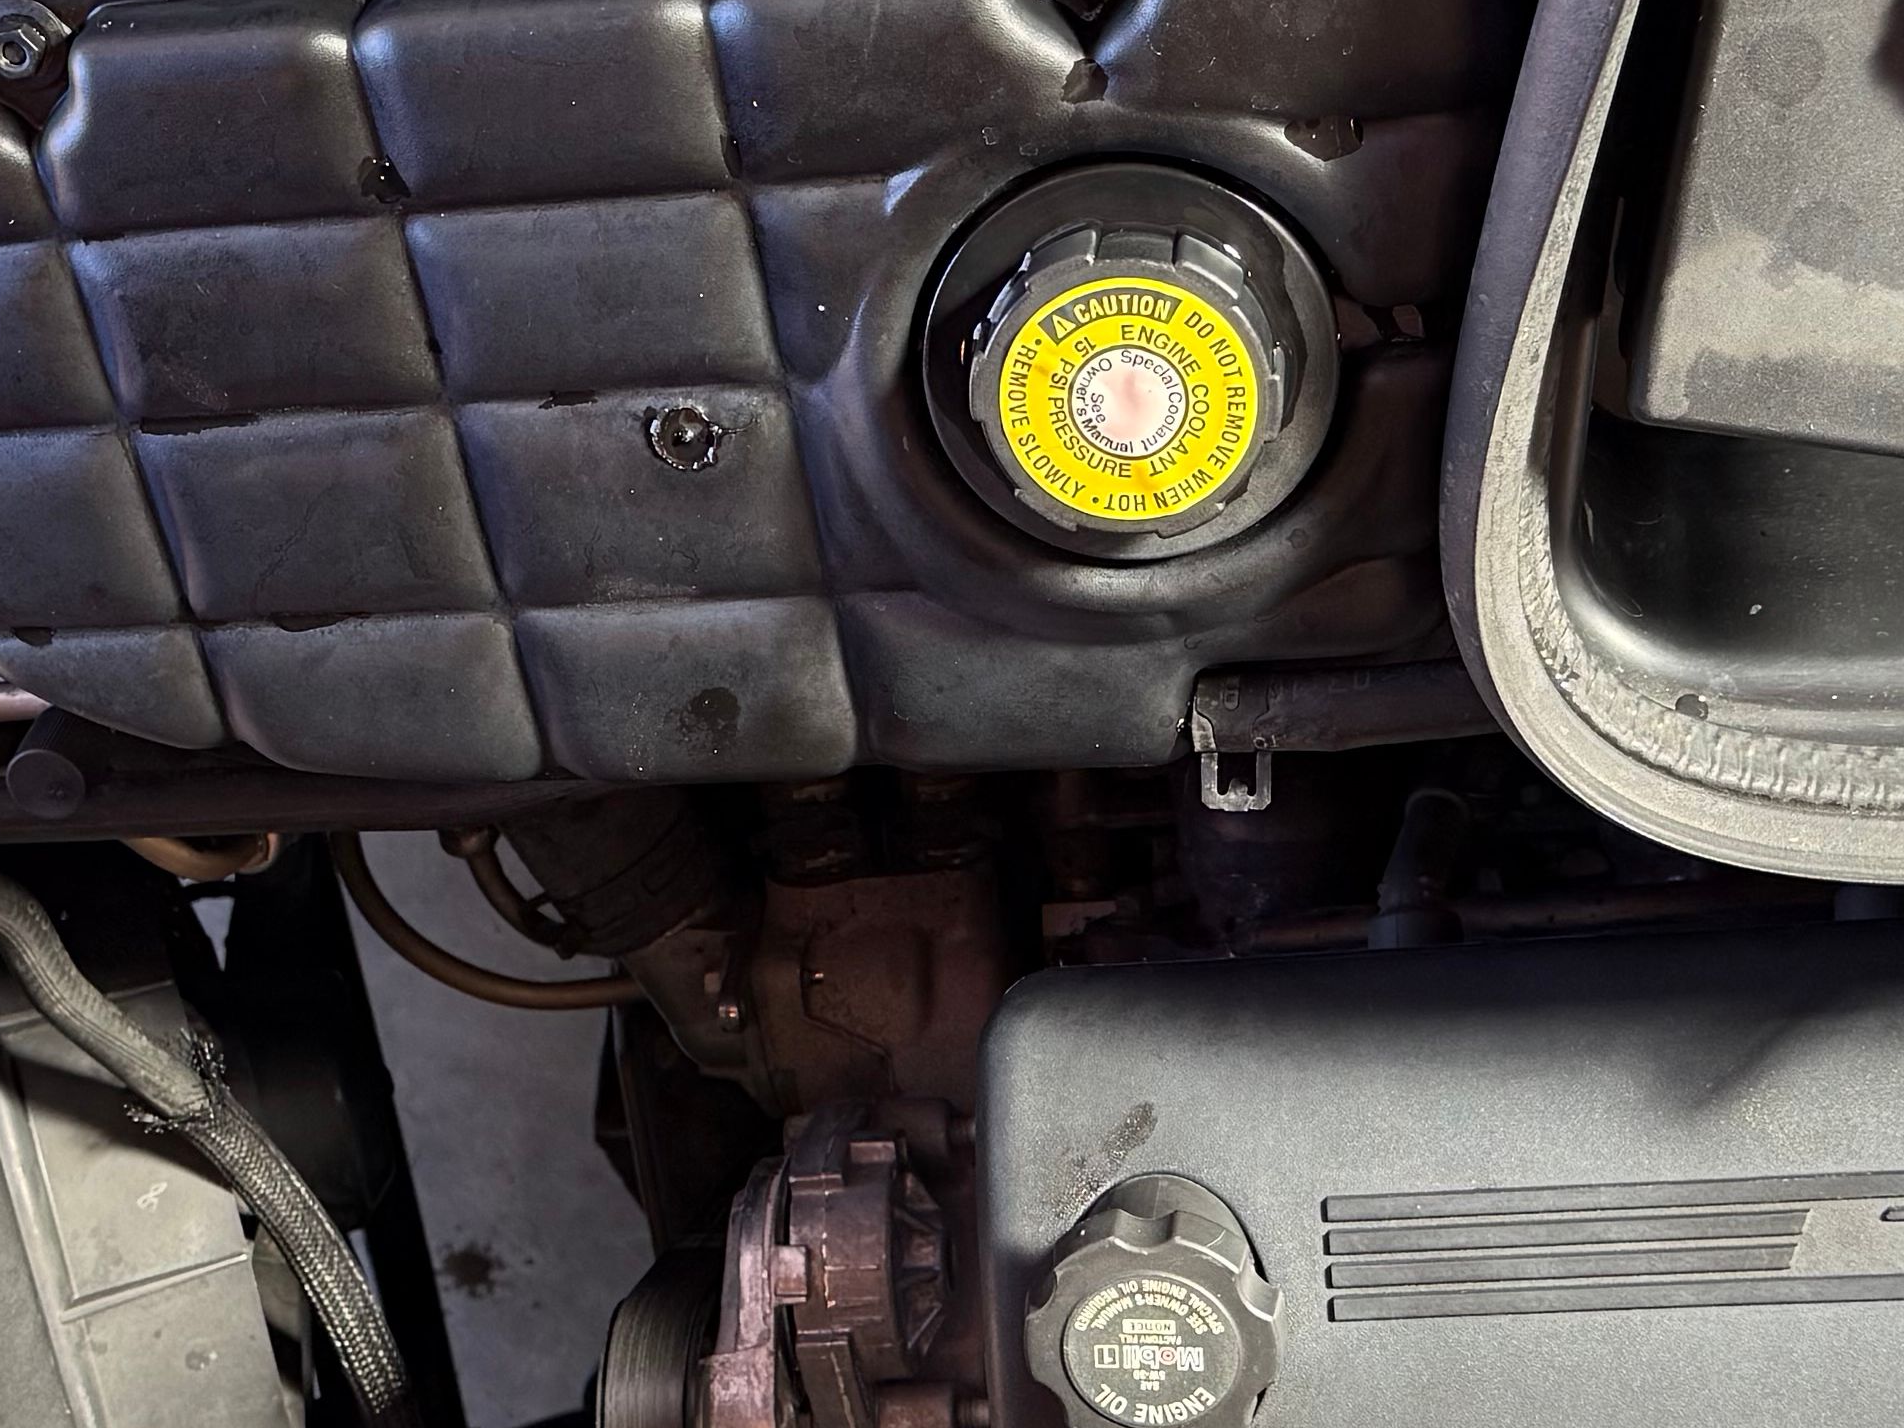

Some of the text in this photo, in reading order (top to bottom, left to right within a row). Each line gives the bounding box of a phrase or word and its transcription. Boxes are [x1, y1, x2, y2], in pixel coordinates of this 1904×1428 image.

[1073, 294, 1171, 324] CAUTION
[1008, 344, 1086, 499] REMOVE SLOWLY
[1048, 337, 1132, 478] 15 PSI PRESSURE
[1076, 357, 1134, 453] Owner's Manual
[1091, 392, 1106, 424] See
[1104, 311, 1246, 511] DO NOT REMOVE WHEN HOT
[1120, 349, 1183, 452] Special Coolant
[1121, 324, 1210, 477] ENGINE COOLANT
[1073, 1280, 1225, 1335] SPECIAL ENGINE OIL REQUIRED
[1090, 1296, 1133, 1330] MANUAL
[1129, 1322, 1171, 1332] NOTICE
[1185, 1313, 1208, 1335] SEE
[1122, 1346, 1205, 1372] Mobil
[1094, 1383, 1216, 1425] ENGINE OIL
